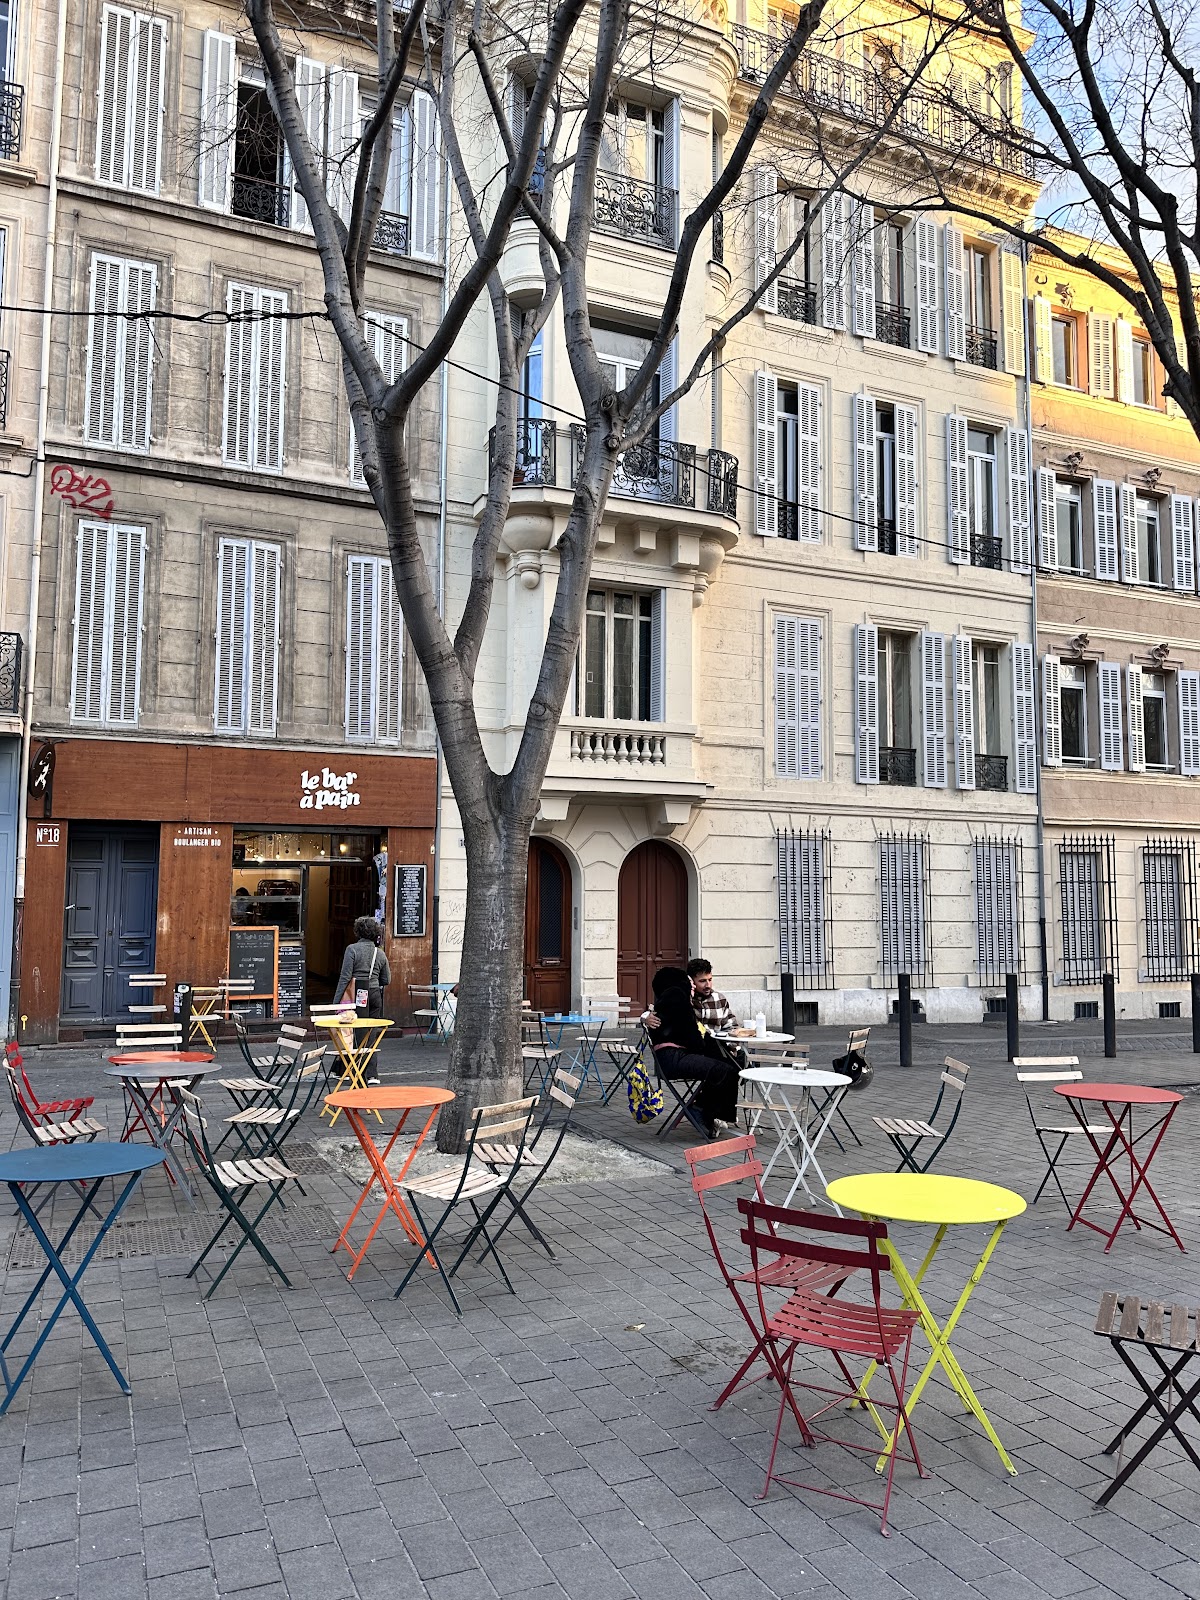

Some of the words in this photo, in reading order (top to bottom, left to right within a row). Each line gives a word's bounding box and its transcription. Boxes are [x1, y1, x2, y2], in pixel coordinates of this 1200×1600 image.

[301, 770, 320, 790] le
[321, 767, 358, 791] bar
[300, 789, 314, 809] à
[314, 790, 360, 810] pain
[184, 827, 212, 836] ARTISAN
[173, 837, 209, 847] BOULANGER
[210, 838, 222, 847] BIO
